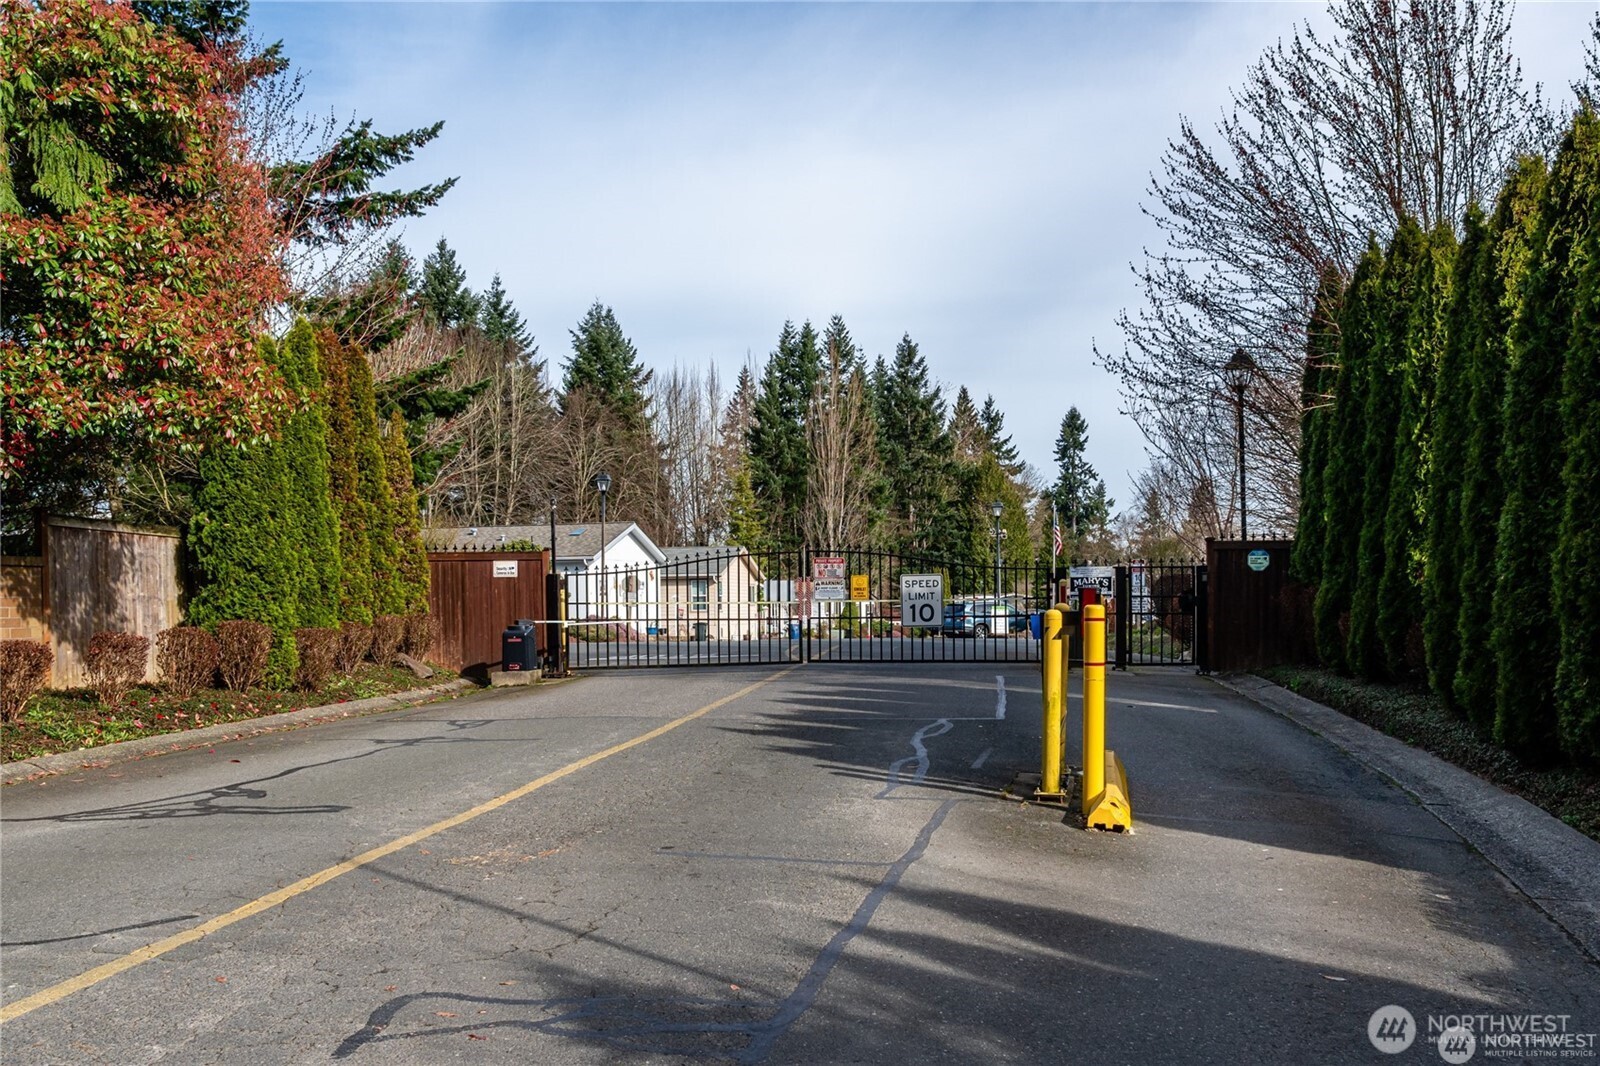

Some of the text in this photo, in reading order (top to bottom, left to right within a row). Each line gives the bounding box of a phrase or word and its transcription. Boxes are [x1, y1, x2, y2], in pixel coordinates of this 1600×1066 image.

[818, 568, 826, 577] NO
[904, 579, 939, 588] SPEED
[1073, 577, 1109, 587] MARY'S
[908, 592, 935, 601] LIMIT
[909, 603, 935, 623] 10
